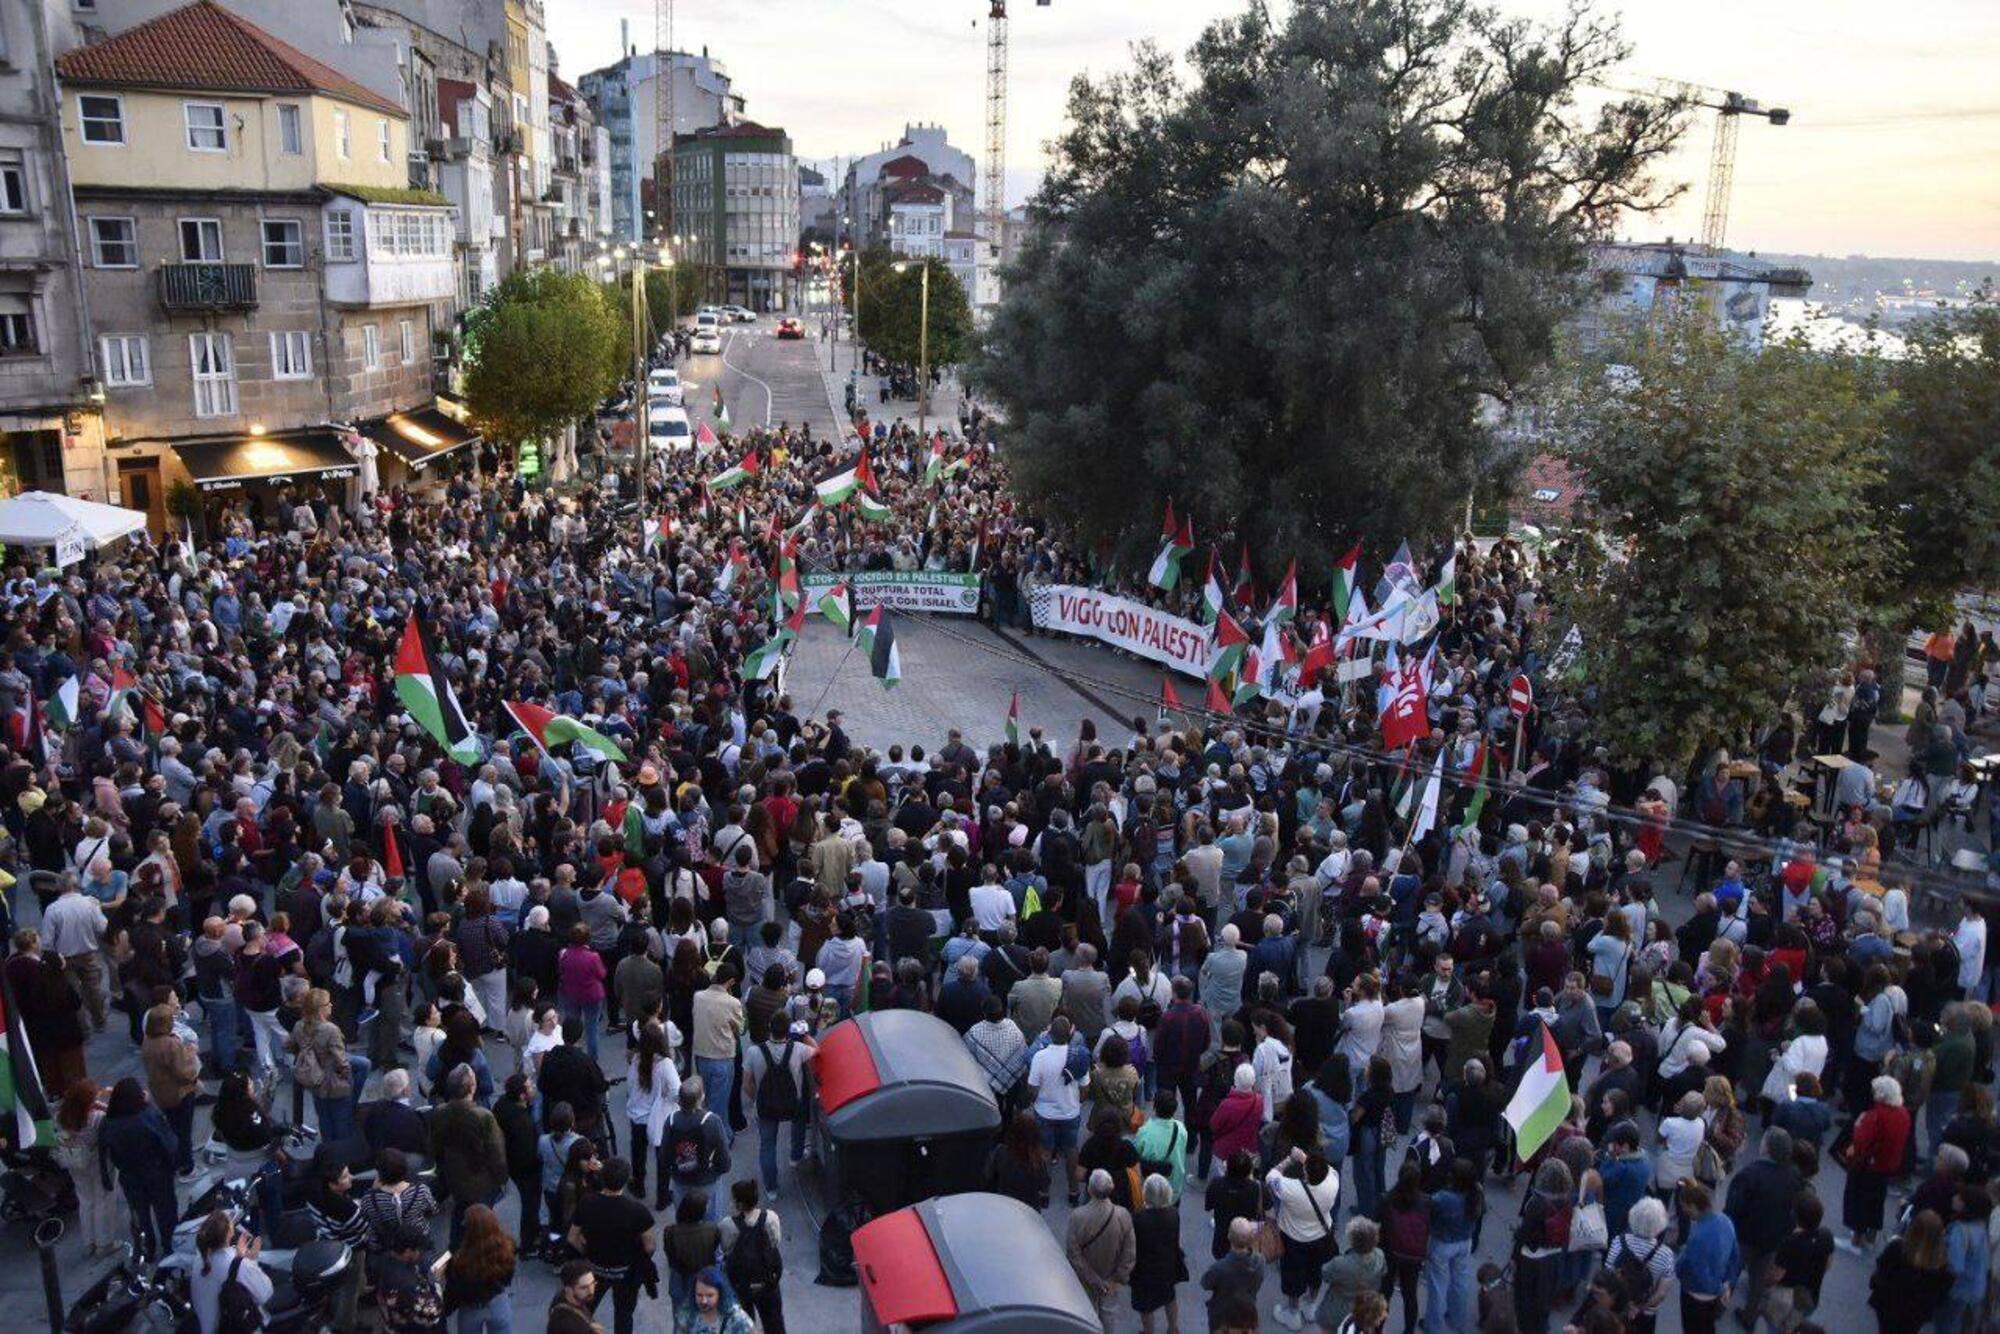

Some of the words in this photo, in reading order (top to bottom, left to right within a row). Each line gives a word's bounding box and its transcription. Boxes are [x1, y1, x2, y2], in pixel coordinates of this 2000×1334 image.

[807, 574, 836, 586] STOP
[896, 571, 911, 582] EN
[861, 584, 910, 595] RUPTURA
[913, 586, 945, 596] TOTAL
[896, 596, 918, 606] CON
[922, 597, 957, 609] ISRAEL
[1059, 594, 1104, 627] VIGO
[1107, 609, 1139, 642] CON
[1141, 617, 1207, 667] PALESTI
